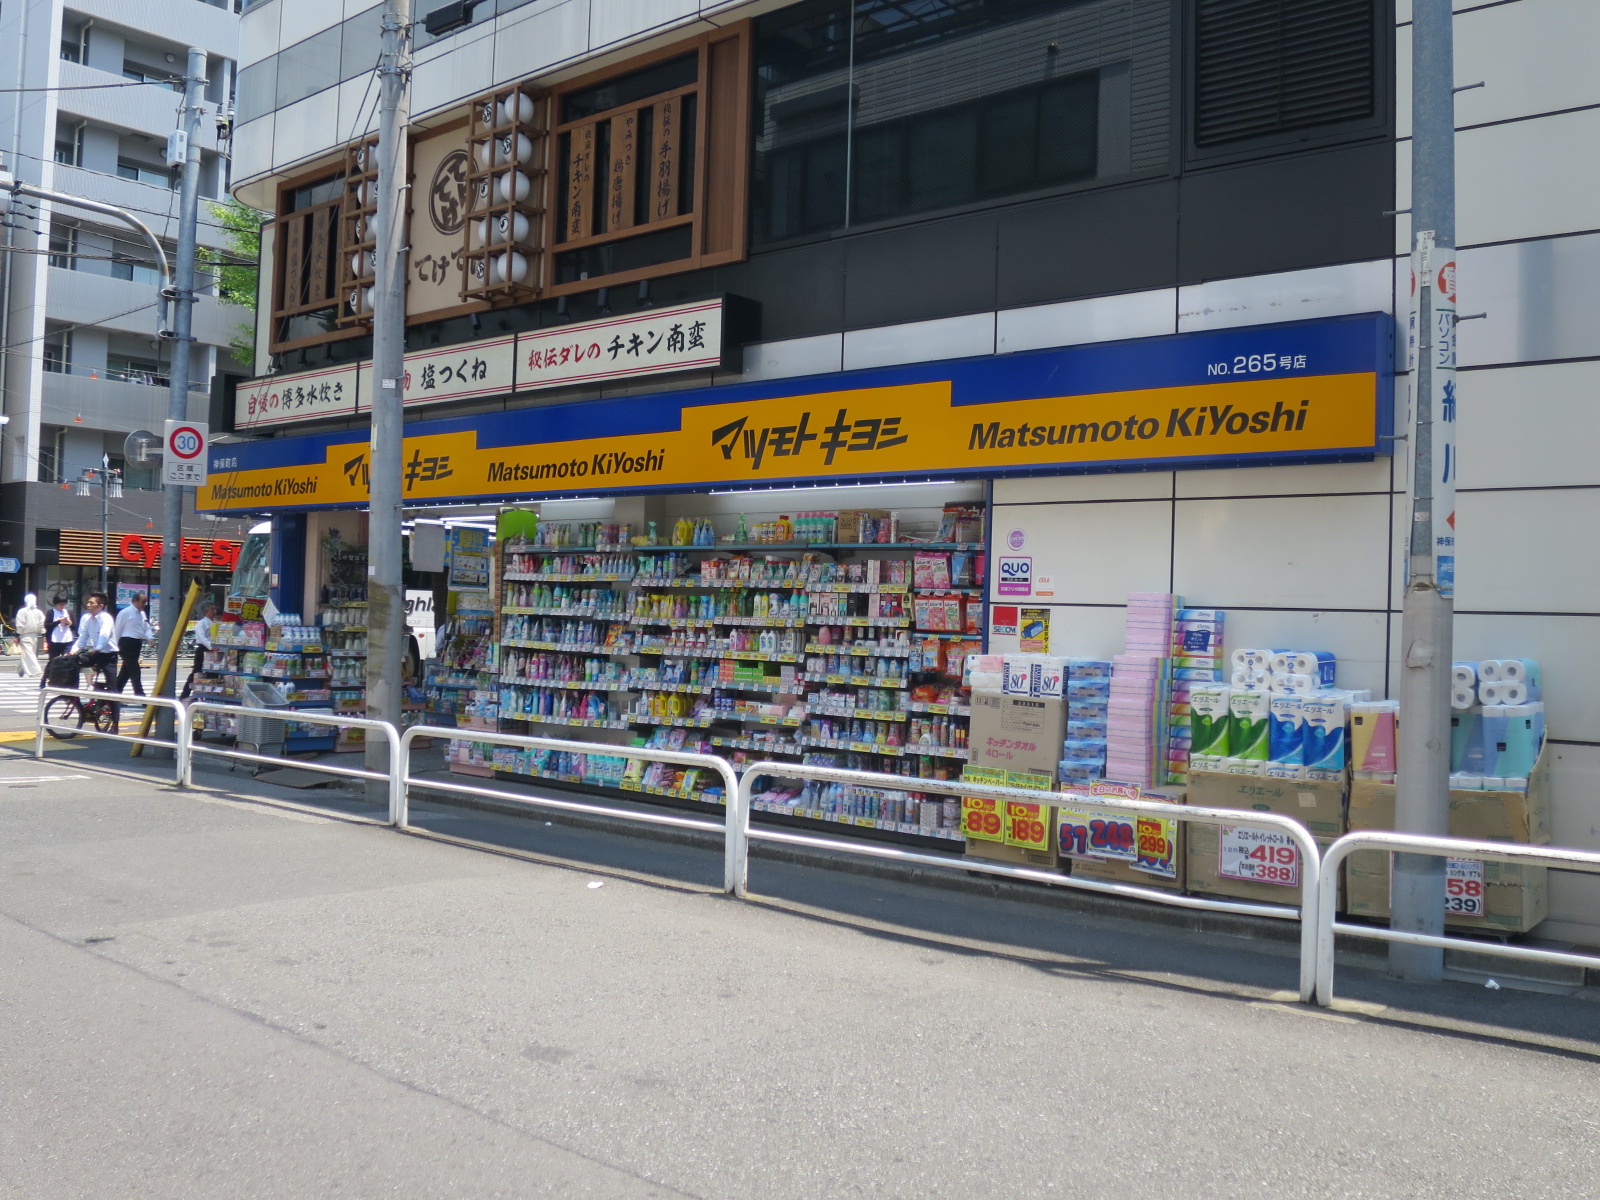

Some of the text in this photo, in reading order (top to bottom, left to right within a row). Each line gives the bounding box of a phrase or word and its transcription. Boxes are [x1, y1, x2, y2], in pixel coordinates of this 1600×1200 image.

[624, 115, 634, 166] やみつき
[657, 141, 672, 217] 手羽揚げ
[571, 153, 584, 235] チキン南蛮
[528, 320, 706, 371] 秘伝ダレの チキン南蛮
[1438, 312, 1450, 365] パソコン
[420, 356, 487, 390] 塩つくね
[247, 380, 344, 416] 自慢の 博多水炊き
[967, 399, 1310, 451] Matsumoto KiYoshi
[177, 435, 196, 451] 30
[213, 457, 238, 470] 神保町店
[486, 448, 665, 483] Matsumoto KiYoshi
[169, 472, 201, 481] ここまで
[211, 476, 318, 500] Matsumoto KiYoshi
[119, 533, 203, 568] Cyle
[1001, 562, 1030, 577] QUO
[993, 625, 1016, 634] SECOM
[1010, 673, 1024, 690] 80
[1042, 676, 1056, 692] 80
[1191, 694, 1220, 704] エリエール
[1230, 697, 1260, 707] エリエール
[1272, 701, 1302, 710] エリエール
[1304, 706, 1335, 715] エリエール
[986, 736, 1037, 752] キッチンタオル
[985, 748, 1014, 760] 4ロール
[1191, 761, 1220, 770] エリエール
[1228, 766, 1258, 776] エリエール
[972, 777, 1004, 787] キッチンペーパー
[1267, 771, 1299, 780] エリエール
[1307, 772, 1340, 782] エリエール
[1238, 785, 1286, 798] エリエール
[967, 797, 984, 809] 10
[1010, 804, 1028, 816] 10
[967, 811, 1001, 834] 89
[1012, 818, 1045, 843] 189
[1139, 835, 1166, 854] 299
[1249, 844, 1295, 865] 419
